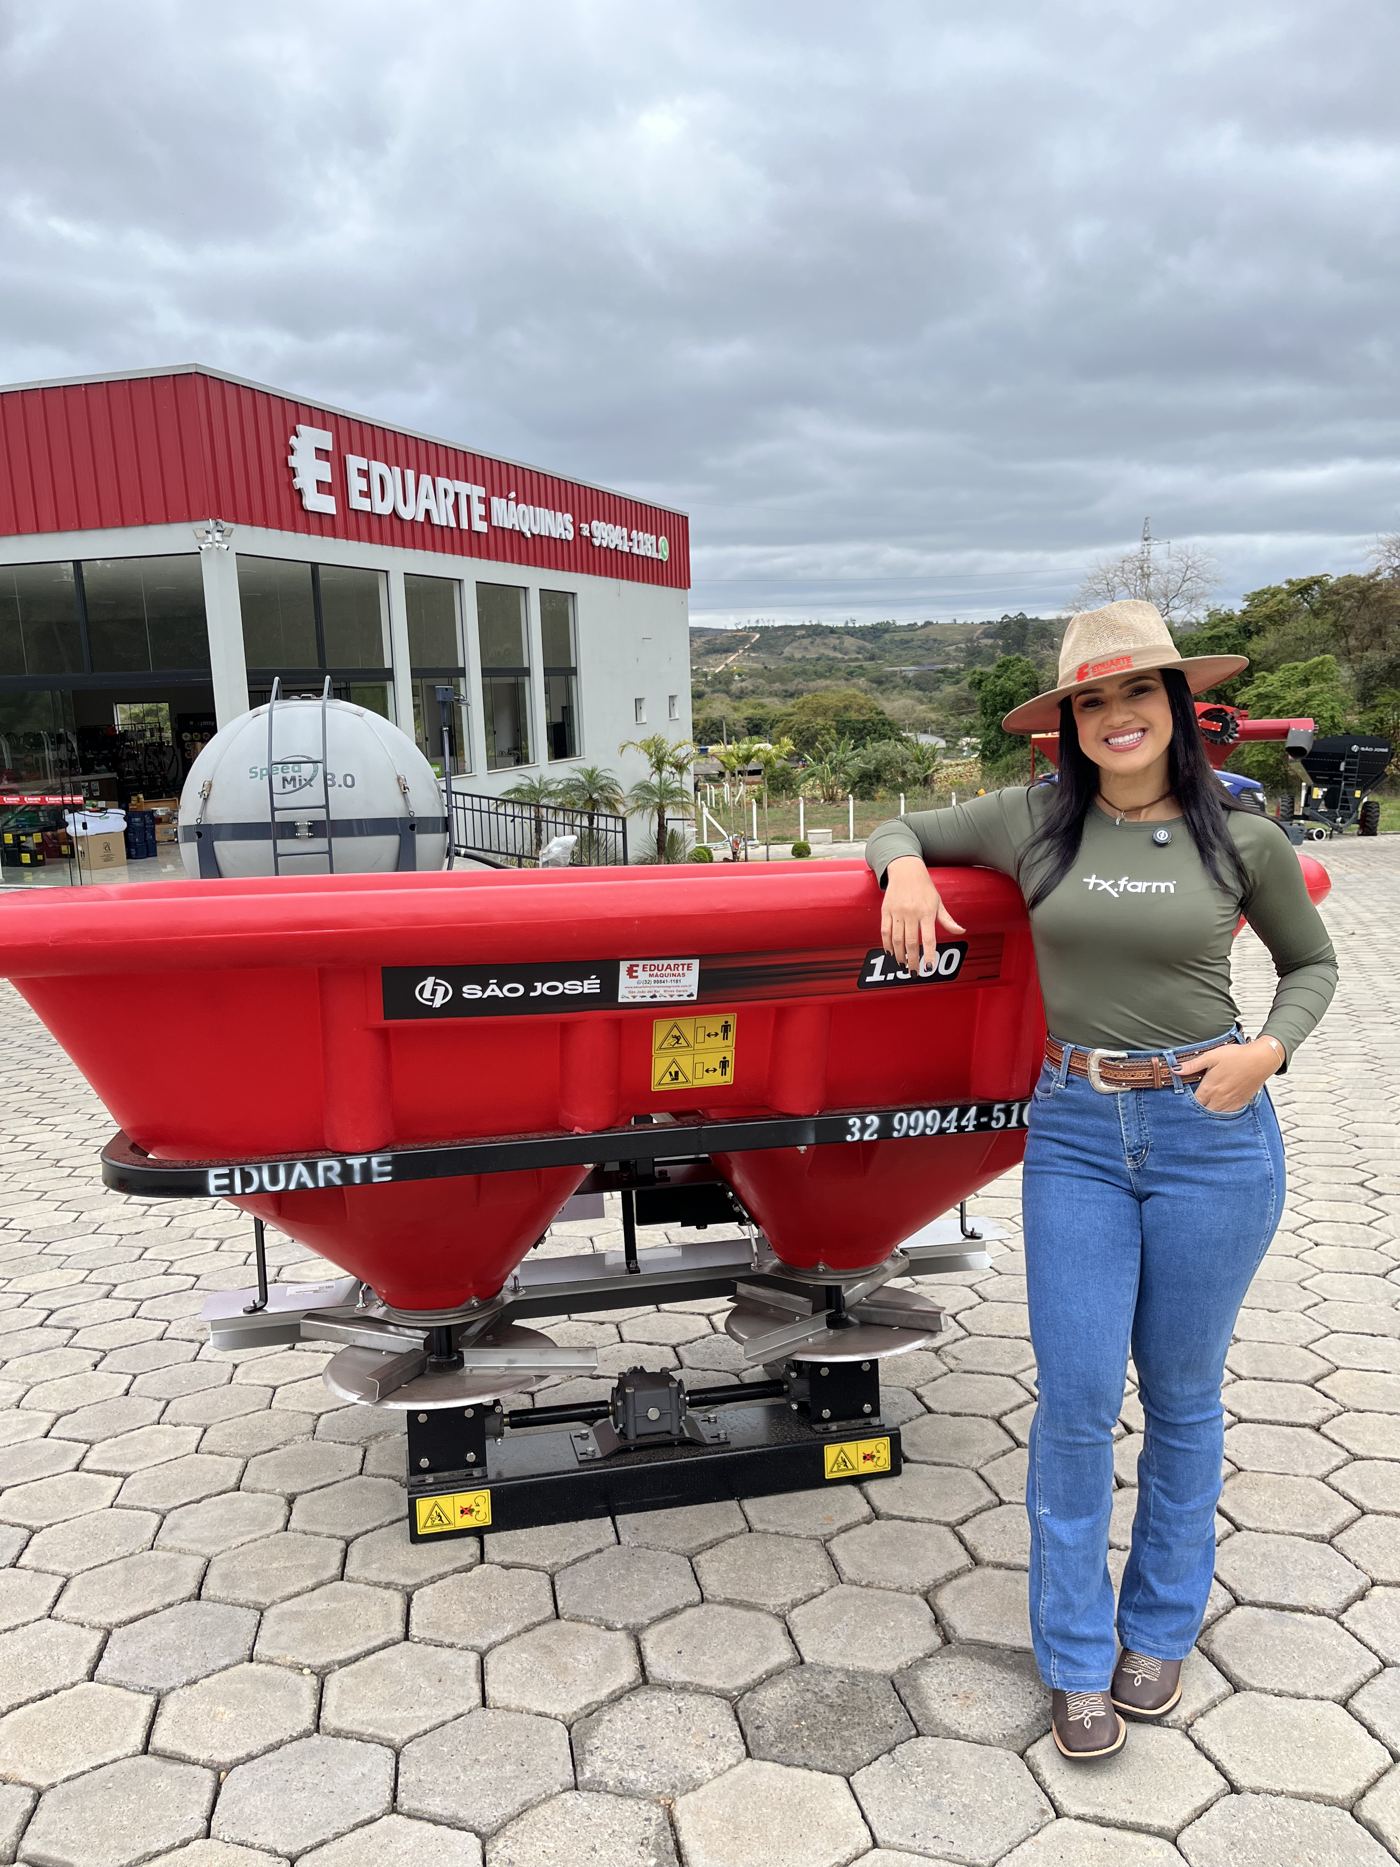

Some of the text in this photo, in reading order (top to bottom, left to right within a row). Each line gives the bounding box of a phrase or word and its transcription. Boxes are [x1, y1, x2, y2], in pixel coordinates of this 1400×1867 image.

[345, 454, 488, 533] EDUARTE
[490, 491, 574, 541] MÁQUINAS
[248, 761, 302, 780] Speed
[281, 775, 314, 789] Mix
[1083, 874, 1175, 898] tx.farm
[642, 963, 693, 972] EDUARTE
[461, 975, 601, 999] SÃO JOSÉ
[845, 1115, 880, 1141] 32
[208, 1155, 393, 1196] EDUARTE
